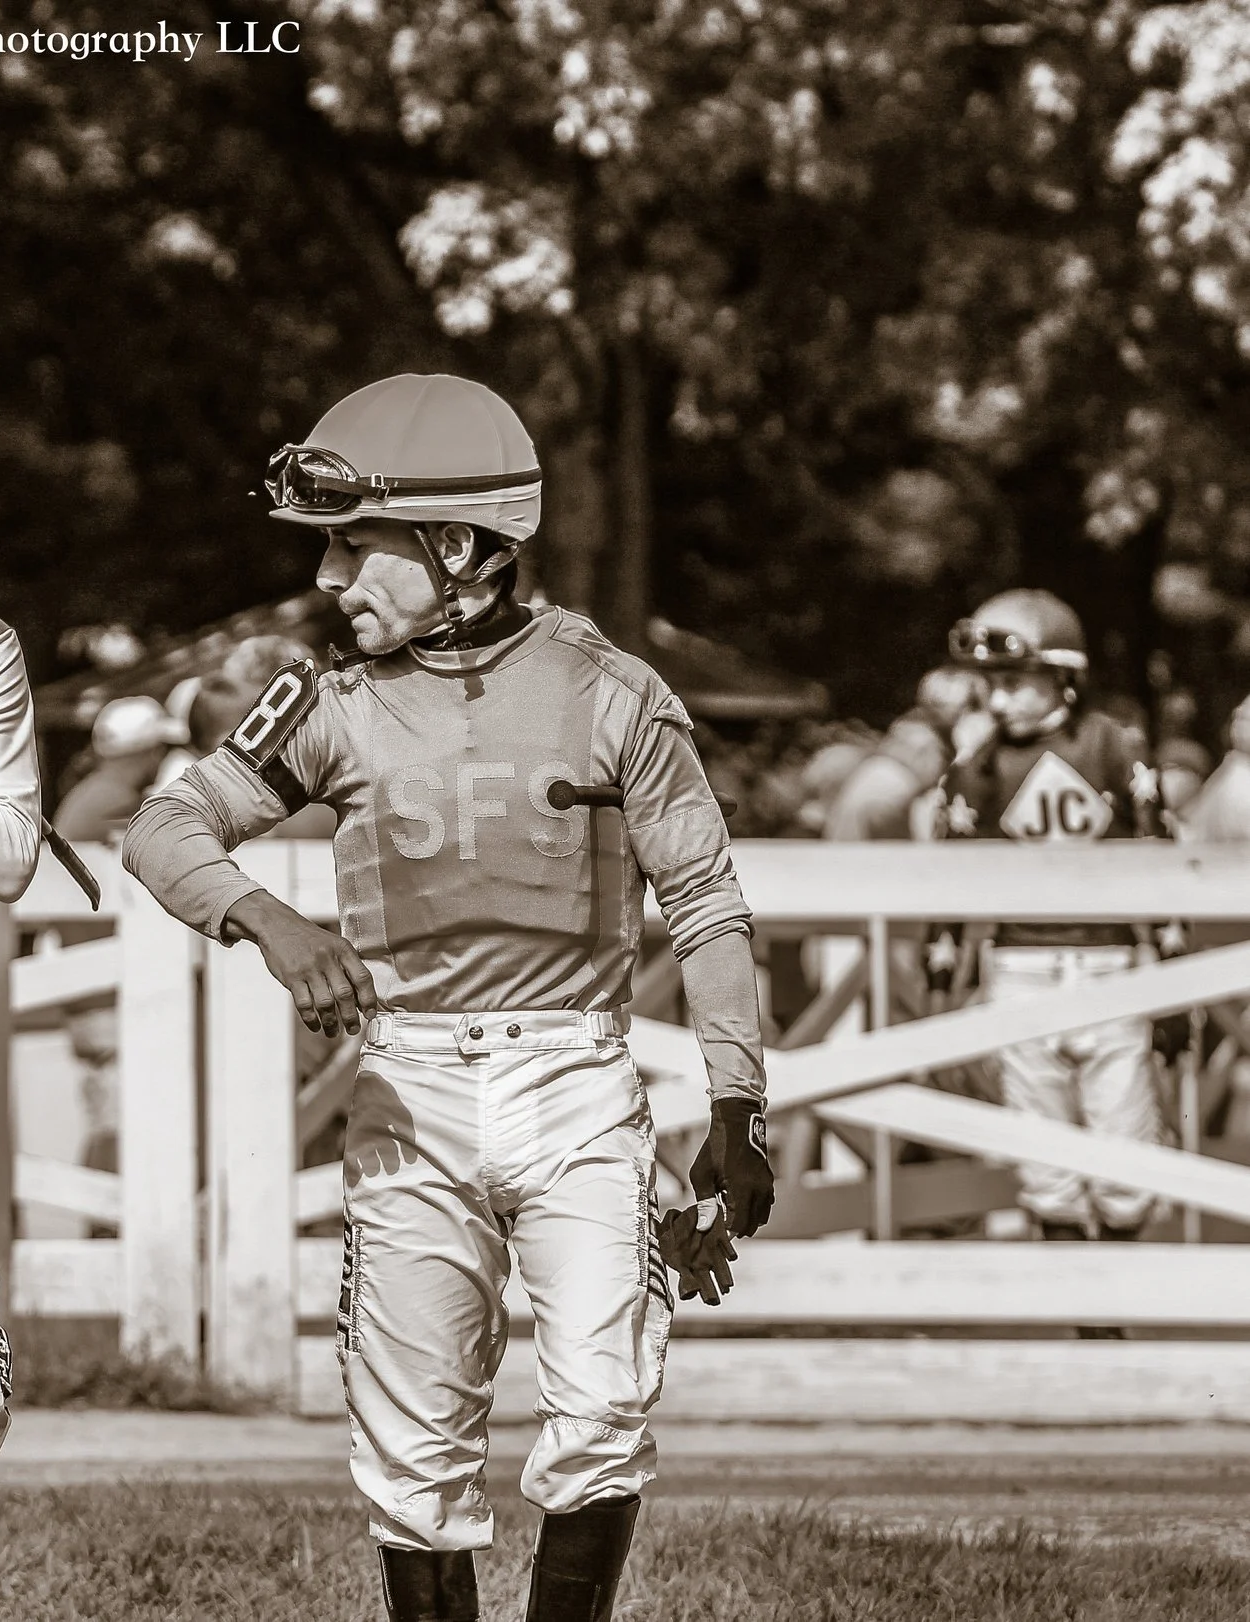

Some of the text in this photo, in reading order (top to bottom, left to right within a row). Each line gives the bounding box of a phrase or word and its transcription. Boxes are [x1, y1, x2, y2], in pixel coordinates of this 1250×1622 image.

[233, 671, 304, 752] 8
[388, 759, 586, 860] SFS
[1023, 787, 1092, 837] JC
